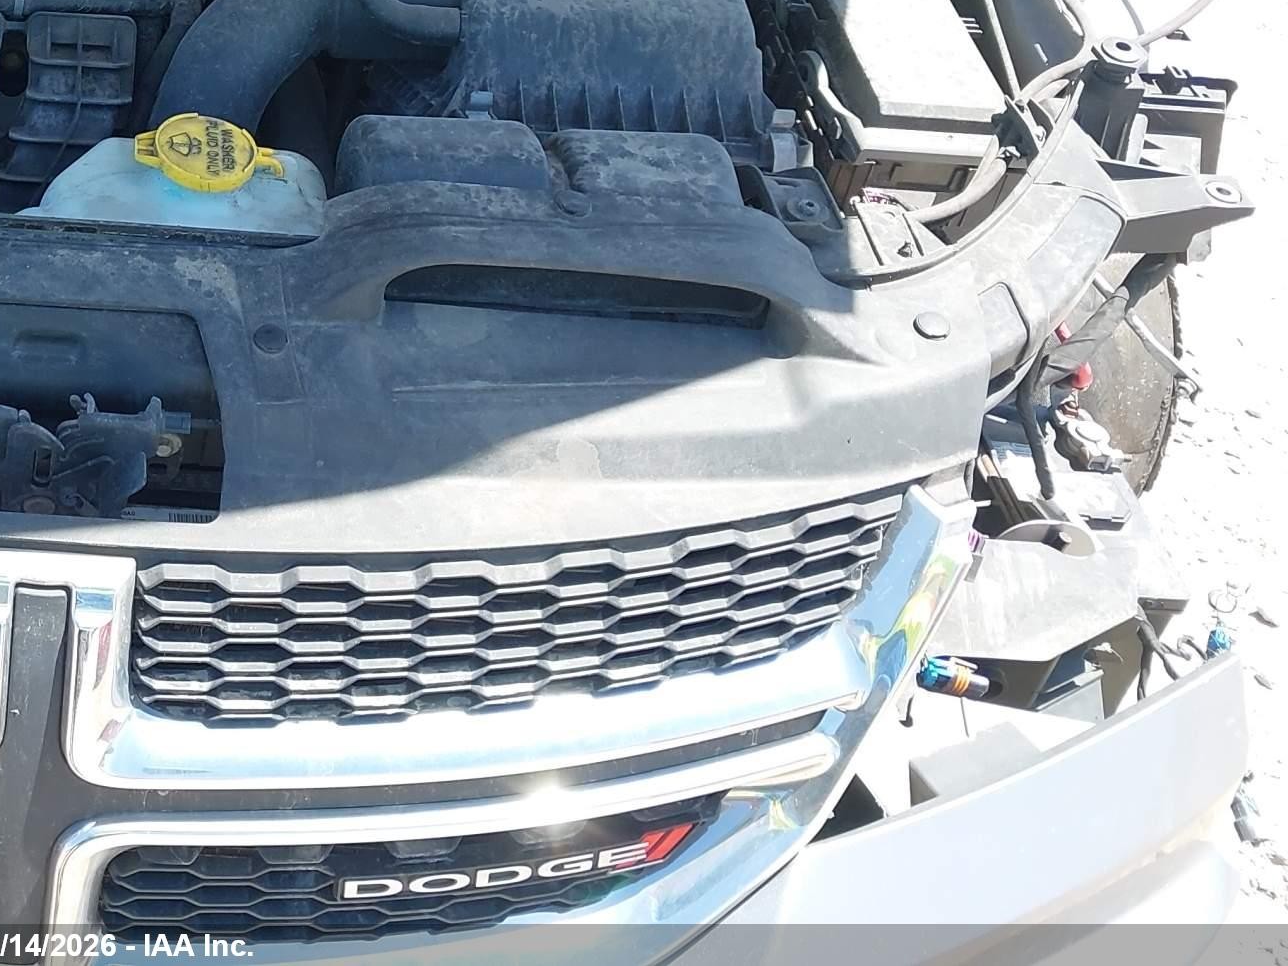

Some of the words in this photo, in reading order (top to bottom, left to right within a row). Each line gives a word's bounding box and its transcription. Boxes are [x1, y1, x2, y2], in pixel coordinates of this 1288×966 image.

[206, 120, 219, 151] FLUID
[221, 128, 235, 173] WASHER
[207, 151, 221, 176] ONLY
[343, 842, 650, 899] DODGE
